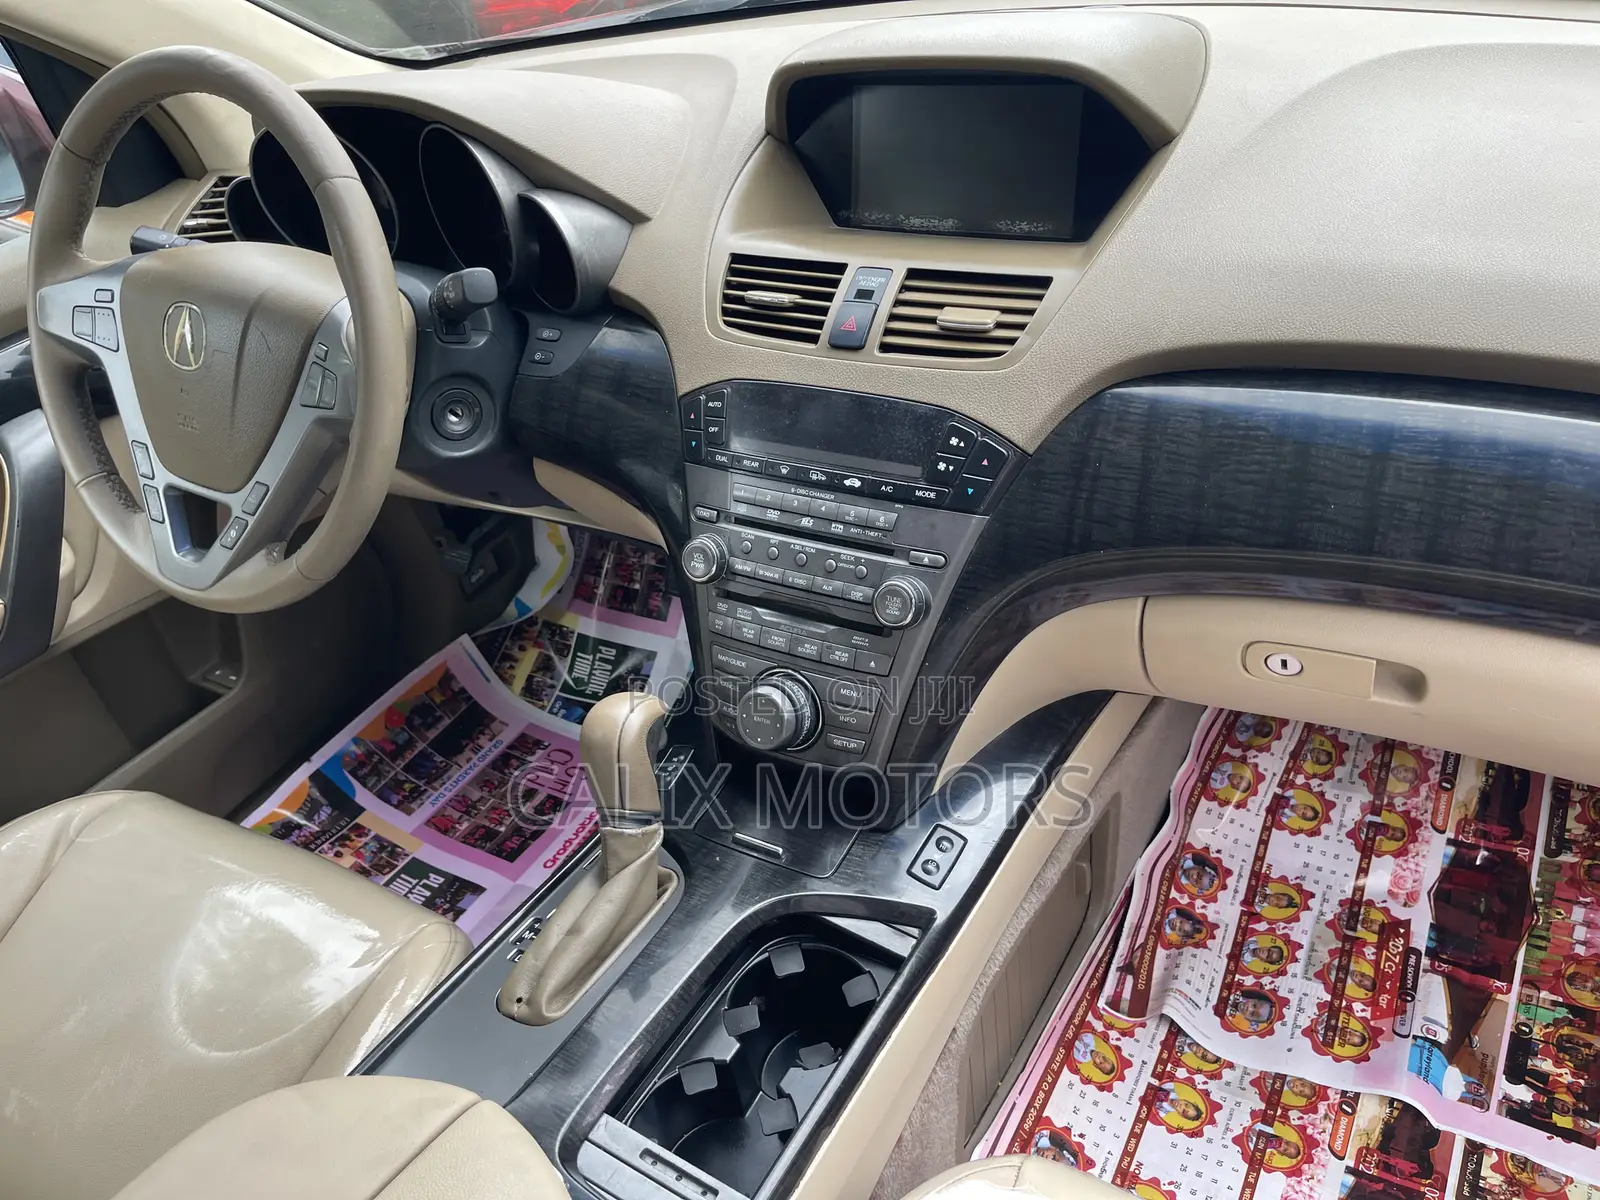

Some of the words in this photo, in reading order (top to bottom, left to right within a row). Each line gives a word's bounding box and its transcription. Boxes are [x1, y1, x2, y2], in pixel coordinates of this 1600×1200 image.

[715, 455, 729, 463] DUAL
[743, 460, 760, 468] REAR
[880, 485, 894, 493] A/C
[809, 490, 835, 500] CHANGER
[915, 490, 936, 499] MODE
[697, 510, 710, 518] LOAD
[741, 532, 754, 540] SCAN
[840, 554, 855, 562] SEEK
[735, 564, 751, 572] AM/FM
[780, 625, 808, 636] ACURA
[768, 639, 786, 647] SOURCE
[771, 635, 786, 643] FRONT
[797, 647, 817, 655] SOURCE
[717, 654, 747, 668] MAP/GUIDE
[572, 652, 594, 682] TIME
[585, 645, 617, 696] PLAYING
[840, 688, 861, 698] MENU
[753, 716, 771, 724] ENTER
[839, 716, 857, 724] INFO
[833, 739, 857, 749] SETUP
[1435, 794, 1448, 826] DIAMOND
[1051, 1046, 1066, 1072] STATE
[1034, 1091, 1046, 1109] BOX
[1134, 1122, 1143, 1134] TUE
[1334, 1116, 1348, 1151] DIAMOND
[1127, 1138, 1137, 1152] WED
[1121, 1156, 1130, 1169] THU
[1248, 1171, 1257, 1184] TUE
